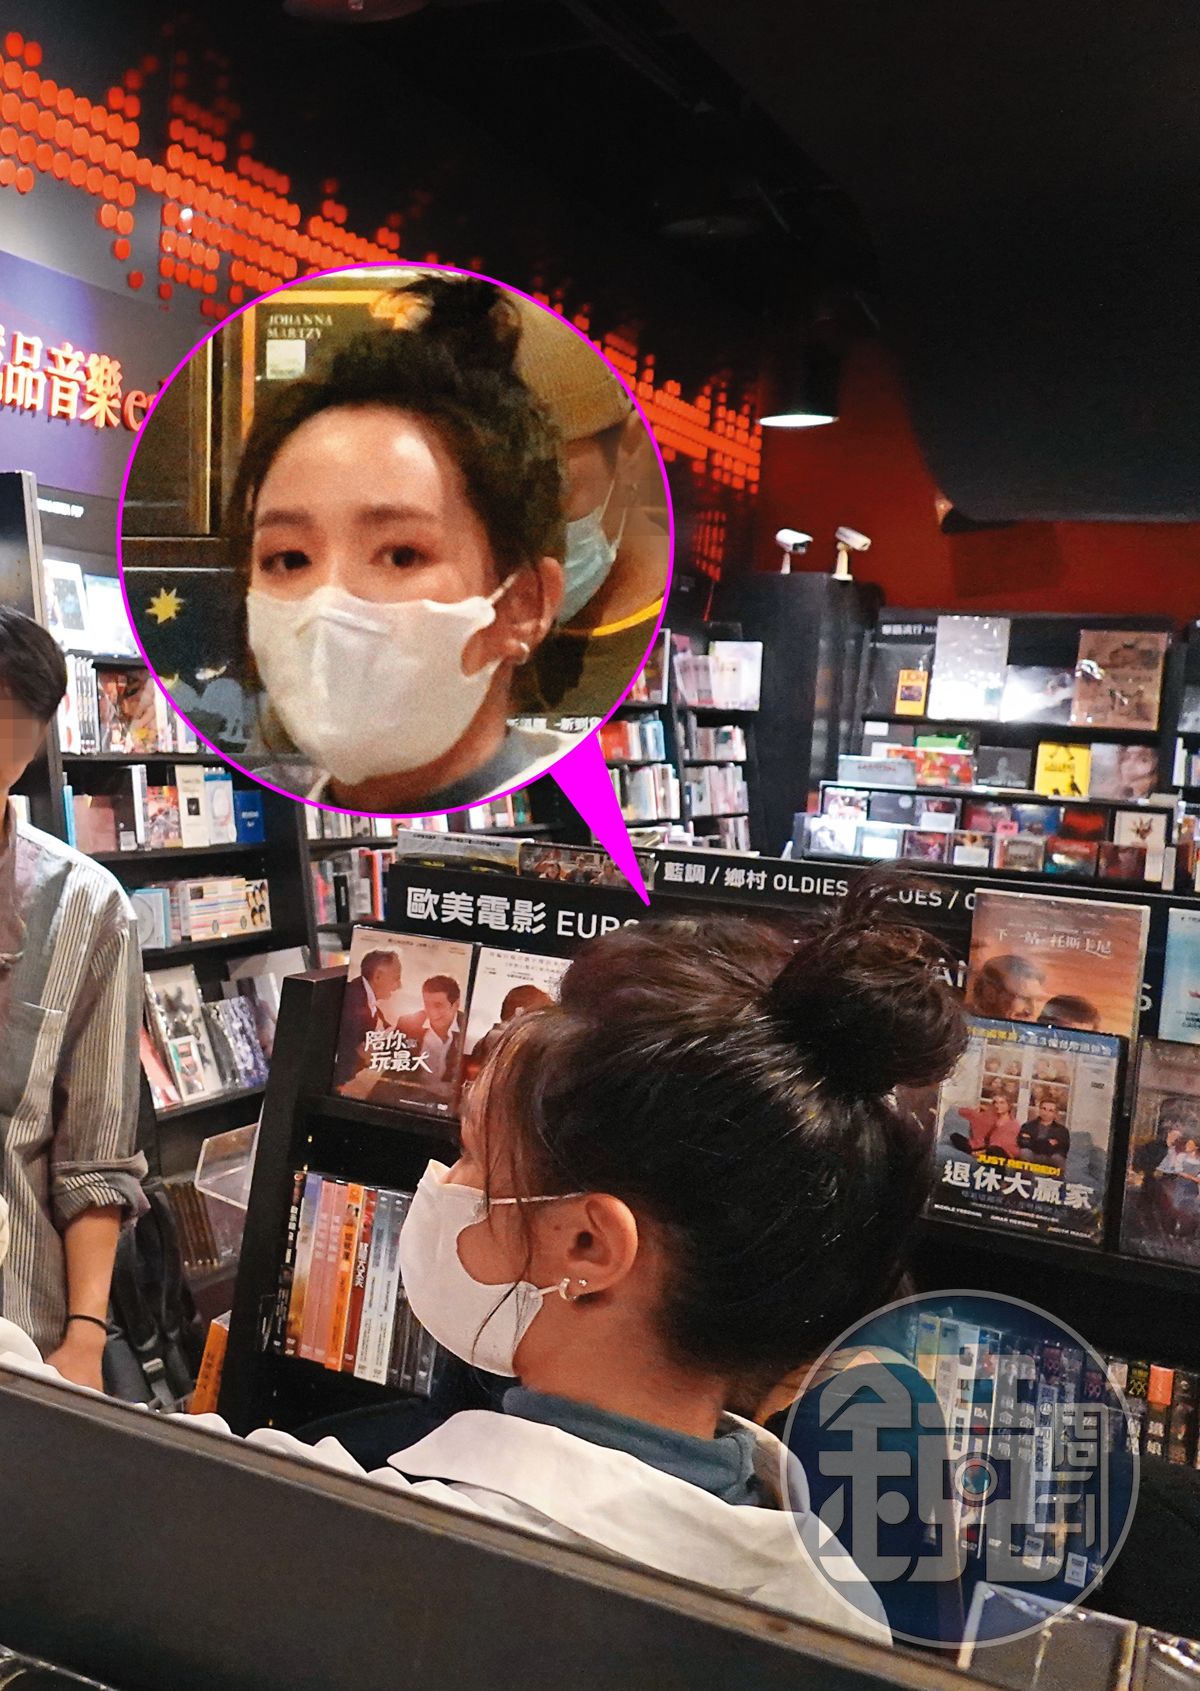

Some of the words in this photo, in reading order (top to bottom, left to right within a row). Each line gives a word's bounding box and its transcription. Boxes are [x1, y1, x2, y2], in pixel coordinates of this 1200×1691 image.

[664, 862, 706, 884] 藍調
[724, 867, 767, 890] 鄉村
[772, 876, 849, 898] OLDIES
[406, 886, 547, 935] 歐美電影
[364, 1030, 407, 1052] 陪你
[368, 1050, 433, 1074] 玩最大
[976, 1153, 1006, 1166] JUST
[942, 1159, 1094, 1210] 退休大贏家
